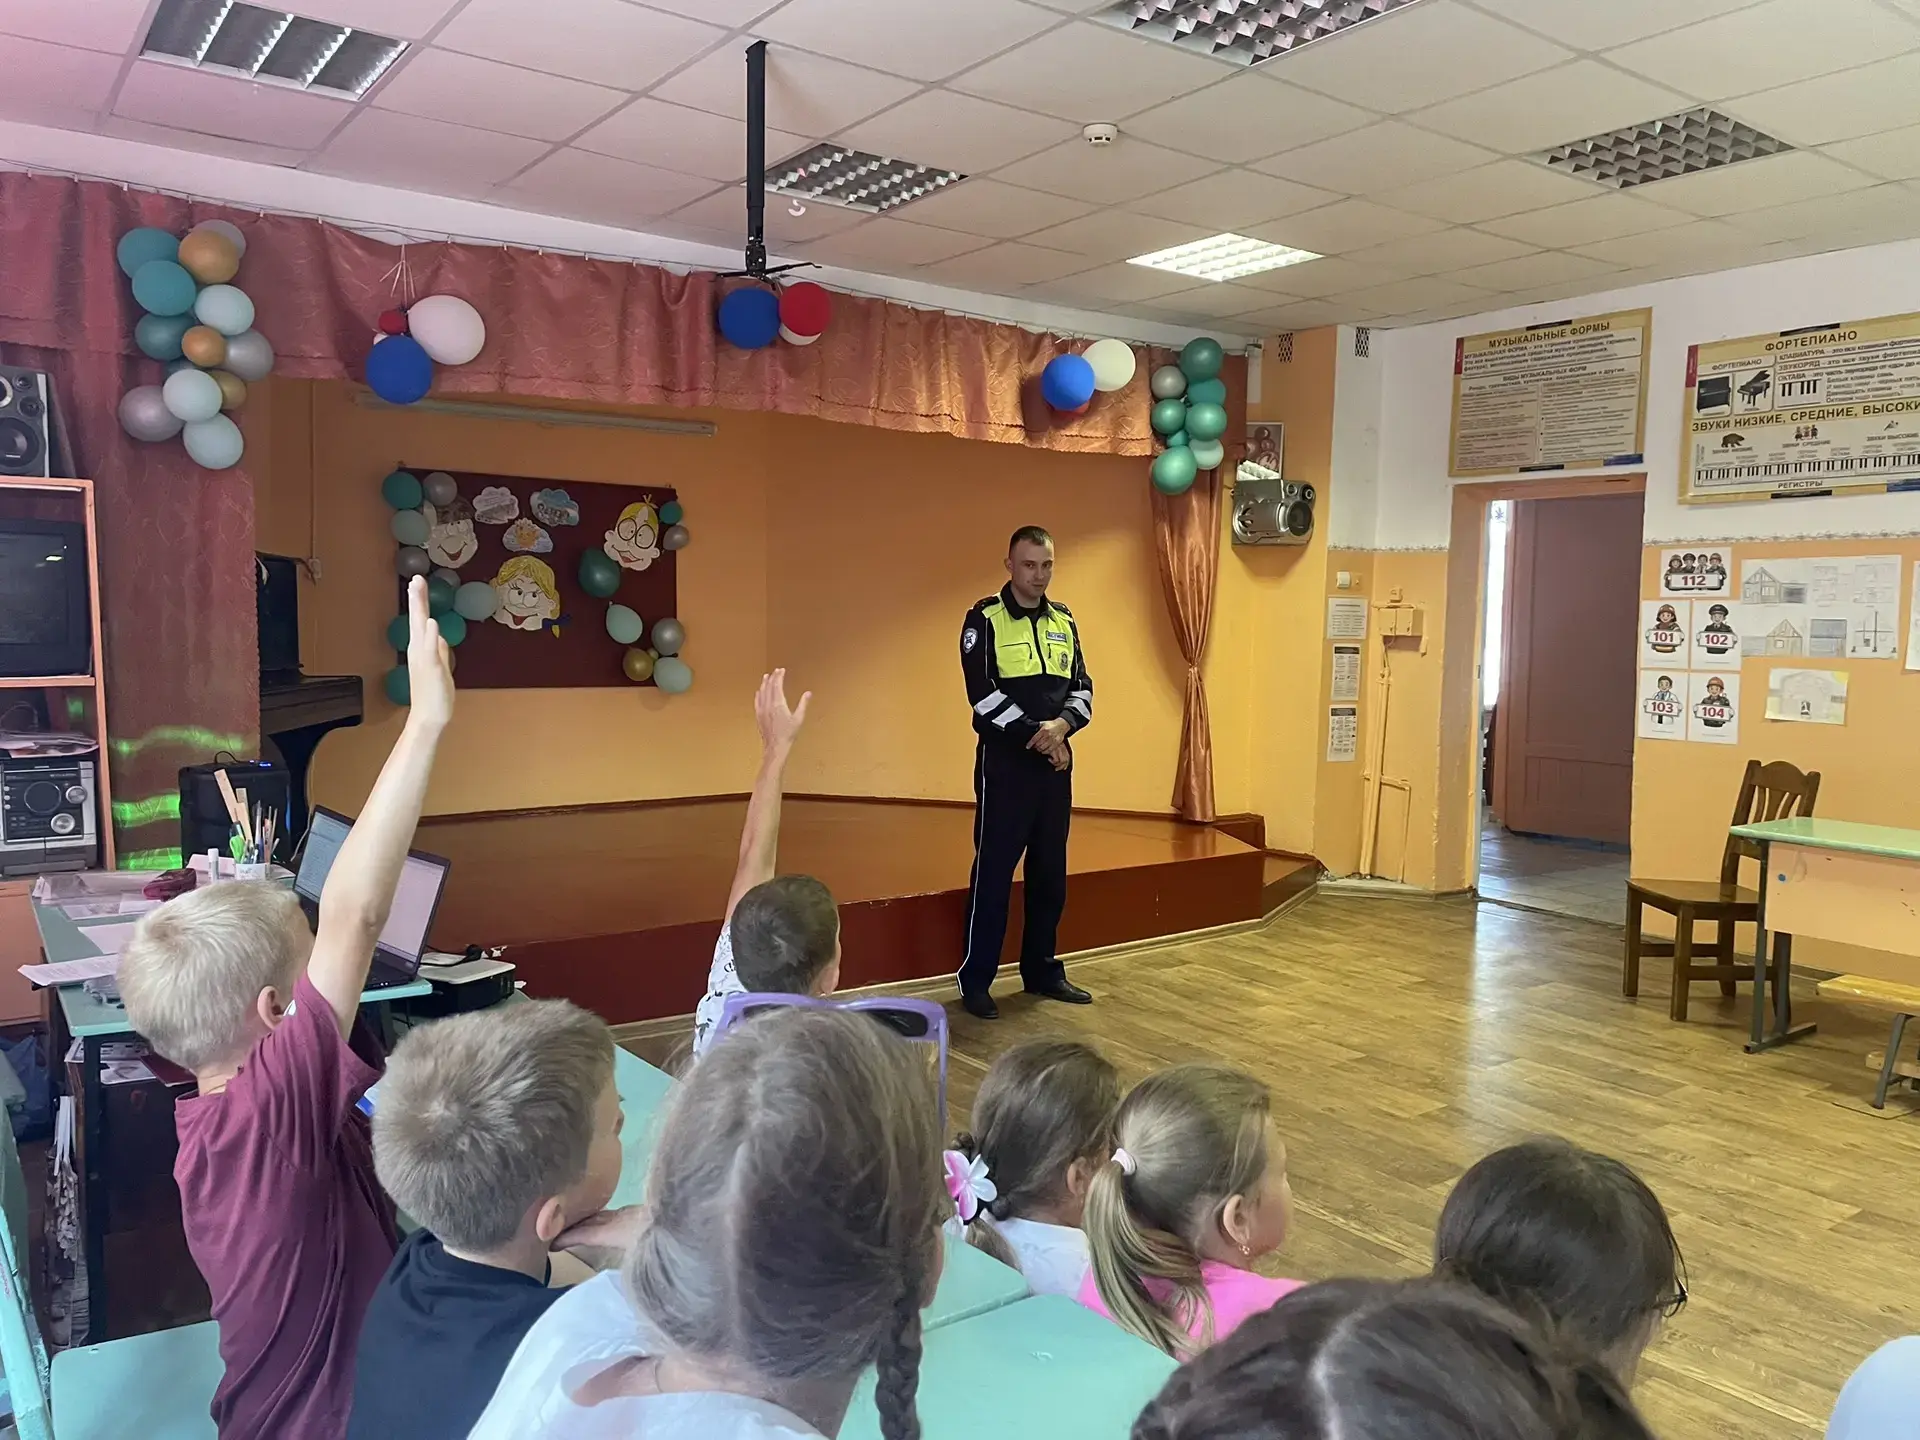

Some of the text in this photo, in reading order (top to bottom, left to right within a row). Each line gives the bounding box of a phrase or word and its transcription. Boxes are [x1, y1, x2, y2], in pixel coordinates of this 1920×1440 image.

[1488, 329, 1567, 348] МУЗЫКАЛЬНЫЕ
[1570, 321, 1610, 336] ФОРМЫ
[1765, 330, 1858, 351] ФОРТЕПИАНО
[1779, 349, 1825, 361] КЛАВИАТУРА
[1711, 358, 1762, 371] ФОРТЕПИАНО
[1778, 360, 1820, 372] ЗВУКОРЯД
[1777, 372, 1806, 382] ОКТАВА
[1692, 419, 1731, 432] ЗВУКИ
[1734, 413, 1786, 428] НИЗКИЕ,
[1790, 406, 1858, 422] СРЕДНИЕ,
[1778, 480, 1823, 489] РЕГИСТРЫ
[1681, 575, 1707, 586] 112
[1653, 631, 1674, 643] 101
[1705, 634, 1729, 646] 102
[1651, 701, 1674, 713] 103
[1702, 706, 1725, 719] 104
